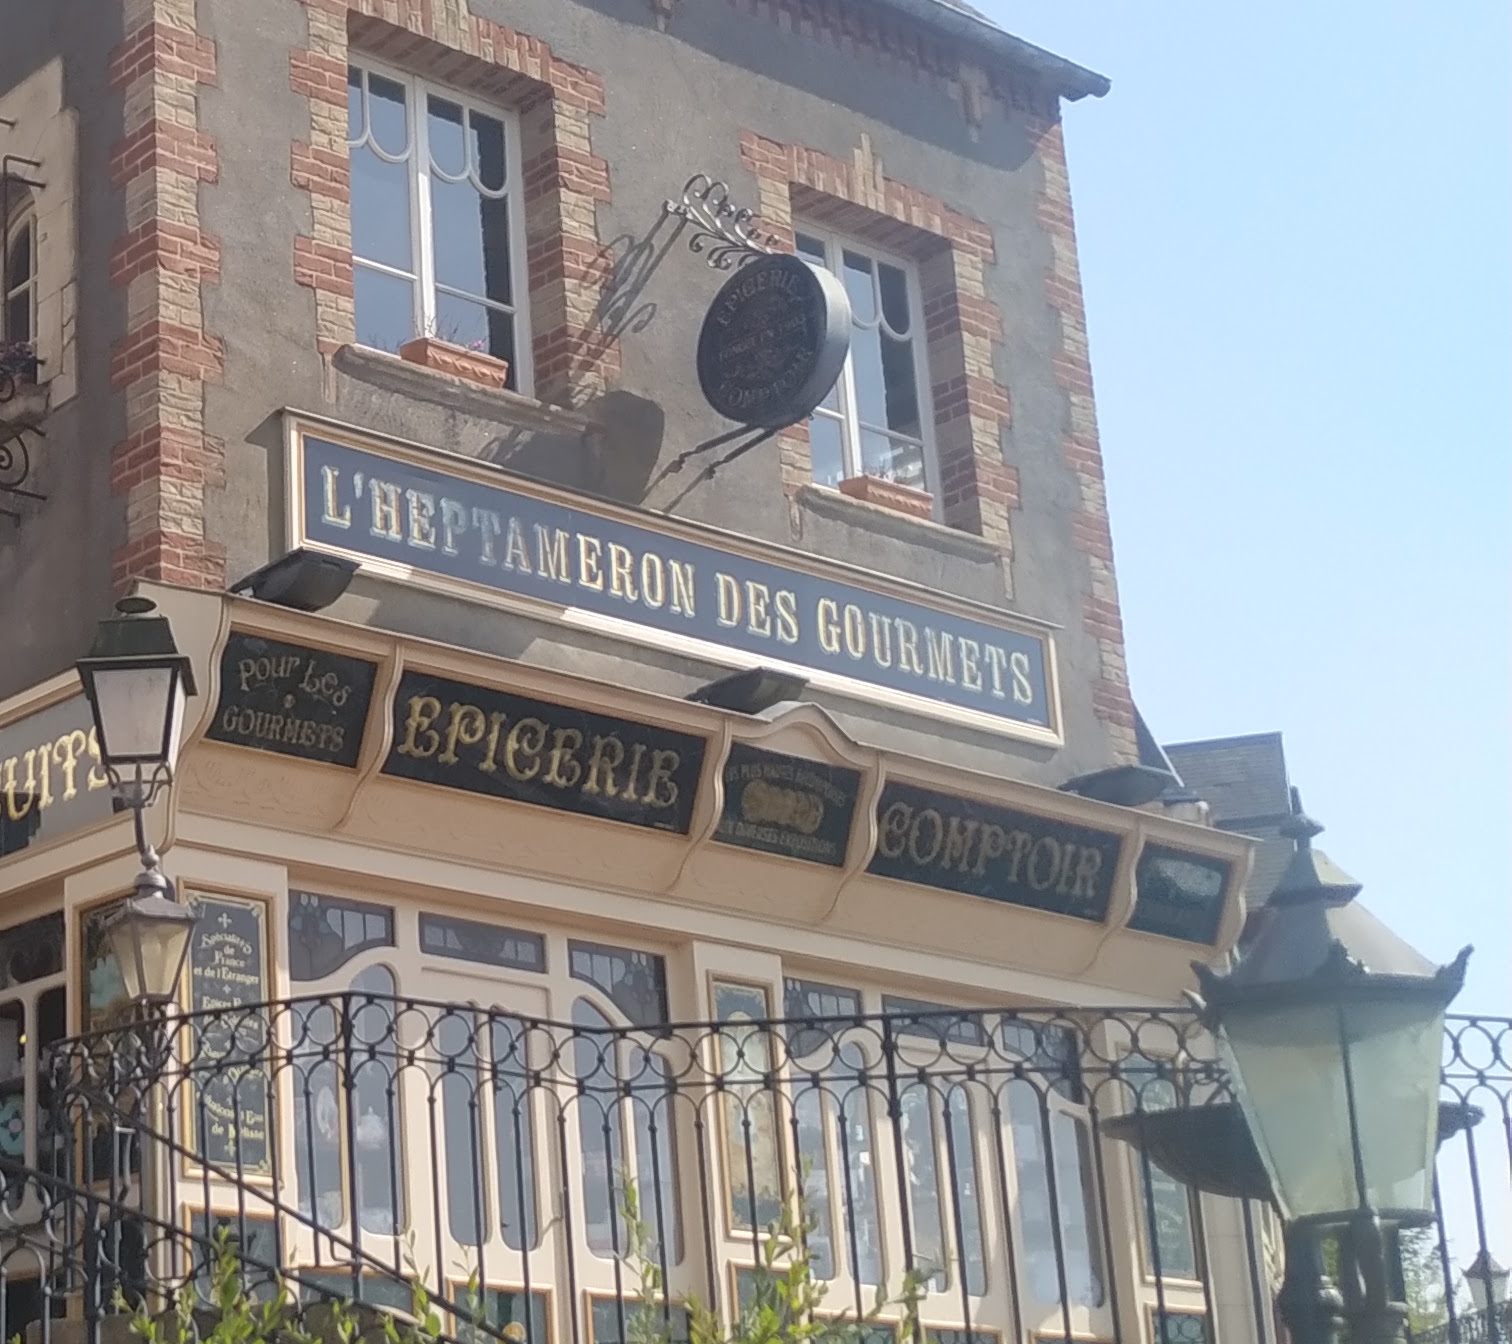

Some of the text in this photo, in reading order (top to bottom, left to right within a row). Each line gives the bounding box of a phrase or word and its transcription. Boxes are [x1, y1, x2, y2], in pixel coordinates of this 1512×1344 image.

[320, 464, 1033, 708] L'HEPTAMERON DES GOURMETS
[222, 705, 345, 752] GOURMETS
[397, 695, 680, 808] EPICERIE
[876, 801, 1103, 899] COMPTOIR
[204, 966, 216, 977] de
[211, 1122, 225, 1136] de
